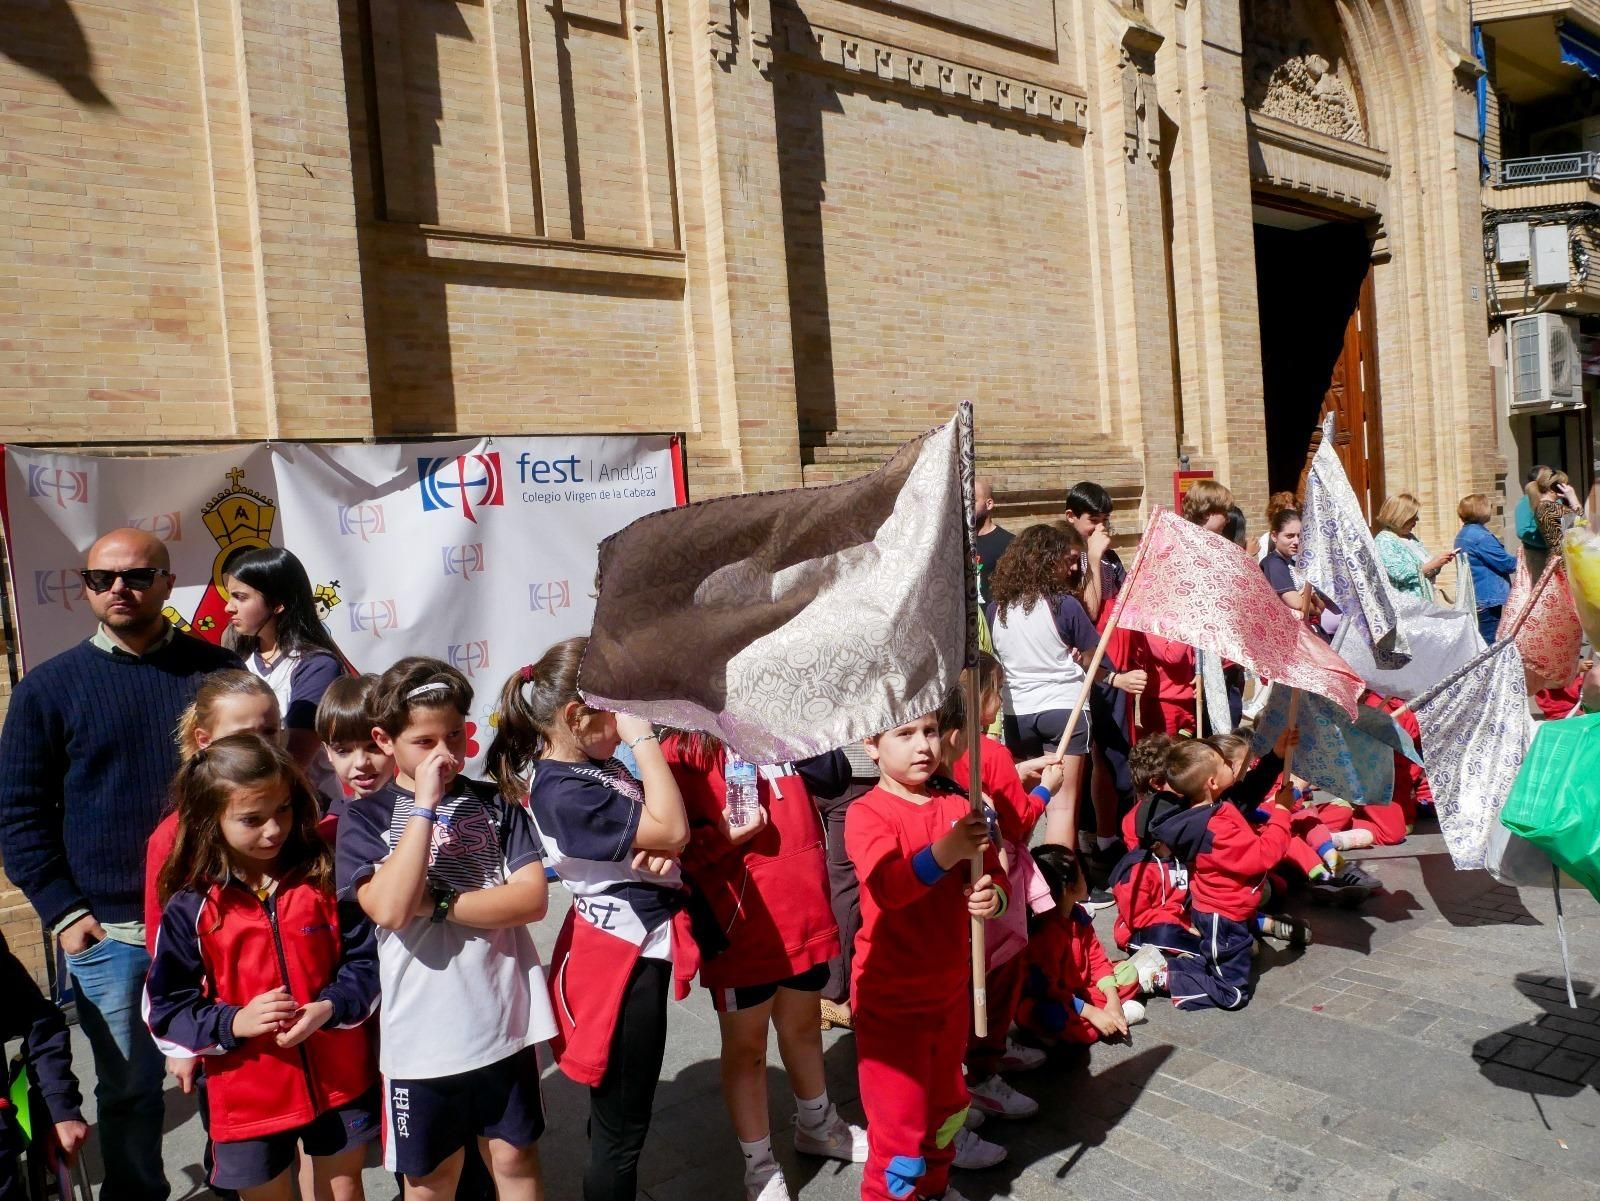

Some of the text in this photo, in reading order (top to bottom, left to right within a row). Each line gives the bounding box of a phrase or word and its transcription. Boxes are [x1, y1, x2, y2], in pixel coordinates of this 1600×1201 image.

[516, 452, 584, 484] fest
[522, 487, 656, 504] Colegio Virgen de la Cabeza
[575, 897, 621, 931] est
[396, 1111, 410, 1139] fest
